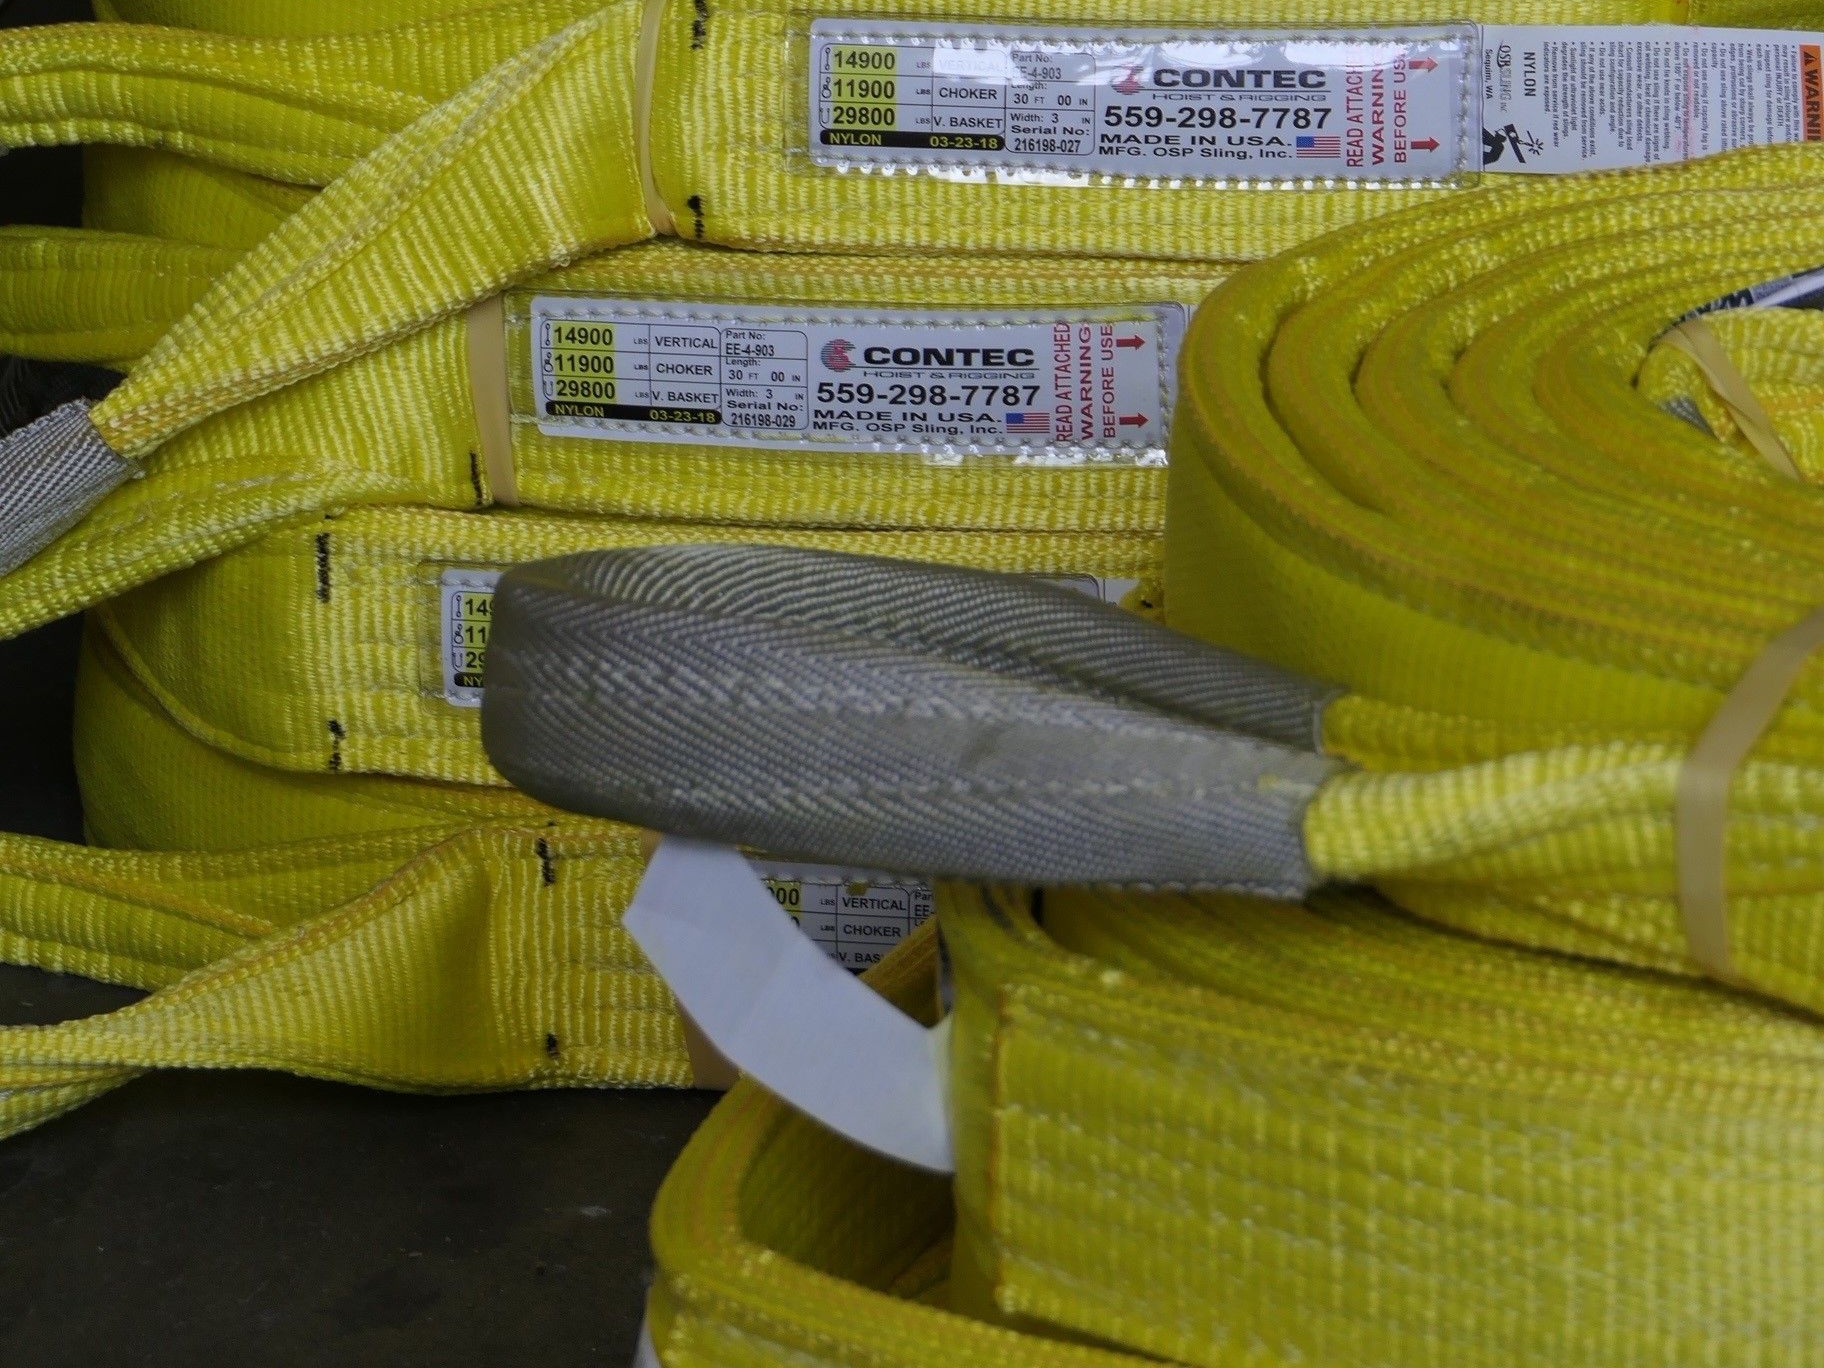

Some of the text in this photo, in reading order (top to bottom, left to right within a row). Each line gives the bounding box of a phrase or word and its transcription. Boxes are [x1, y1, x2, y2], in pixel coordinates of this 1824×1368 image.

[834, 51, 896, 70] 14900
[1152, 69, 1326, 89] CONTEC
[1484, 48, 1494, 100] Sequim, WA
[1524, 52, 1537, 97] NYLON
[834, 80, 895, 100] 11900
[939, 88, 998, 100] CHOKER
[1014, 94, 1072, 106] 30 00
[1805, 69, 1821, 140] WARNI
[833, 106, 895, 126] 29800
[950, 117, 1002, 128] BASKET
[1010, 112, 1044, 123] Width:
[1104, 105, 1332, 129] 559-298-7787
[1012, 125, 1089, 136] Serial No:
[1394, 89, 1408, 164] BEFORE
[829, 133, 882, 146] NYLON
[930, 136, 998, 150] 03-23-18
[1014, 137, 1080, 153] 216198-027
[1099, 134, 1292, 147] MADE IN USA.
[1099, 145, 1147, 157] MFG.
[1153, 147, 1193, 158] OSP
[1259, 148, 1292, 159] Inc.
[1347, 129, 1364, 168] READ
[554, 327, 613, 346] 14900
[654, 336, 718, 349] VERTICAL
[725, 330, 766, 341] Part No:
[725, 344, 775, 357] EE-4-903
[864, 347, 1034, 367] CONTEC
[555, 354, 614, 374] 11900
[656, 363, 713, 376] CHOKER
[725, 358, 761, 368] Length:
[728, 369, 785, 383] 30 00
[1053, 320, 1072, 443] READ ATTACHED
[1078, 326, 1093, 440] WARNING
[1100, 325, 1116, 438] BEFORE USE
[556, 380, 615, 400] 29800
[725, 388, 758, 398] Width:
[817, 383, 1040, 407] 559-298-7787
[668, 391, 719, 404] BASKET
[555, 404, 604, 418] NYLON
[727, 399, 803, 411] Serial No:
[650, 409, 716, 423] 03-23-18
[731, 413, 796, 427] 216198-029
[813, 410, 1002, 423] MADE IN USA.
[812, 422, 859, 432] MFG.
[865, 423, 905, 433] OSP
[969, 425, 1002, 434] Inc.
[842, 897, 906, 911] VERTICAL
[843, 925, 901, 937] CHOKER
